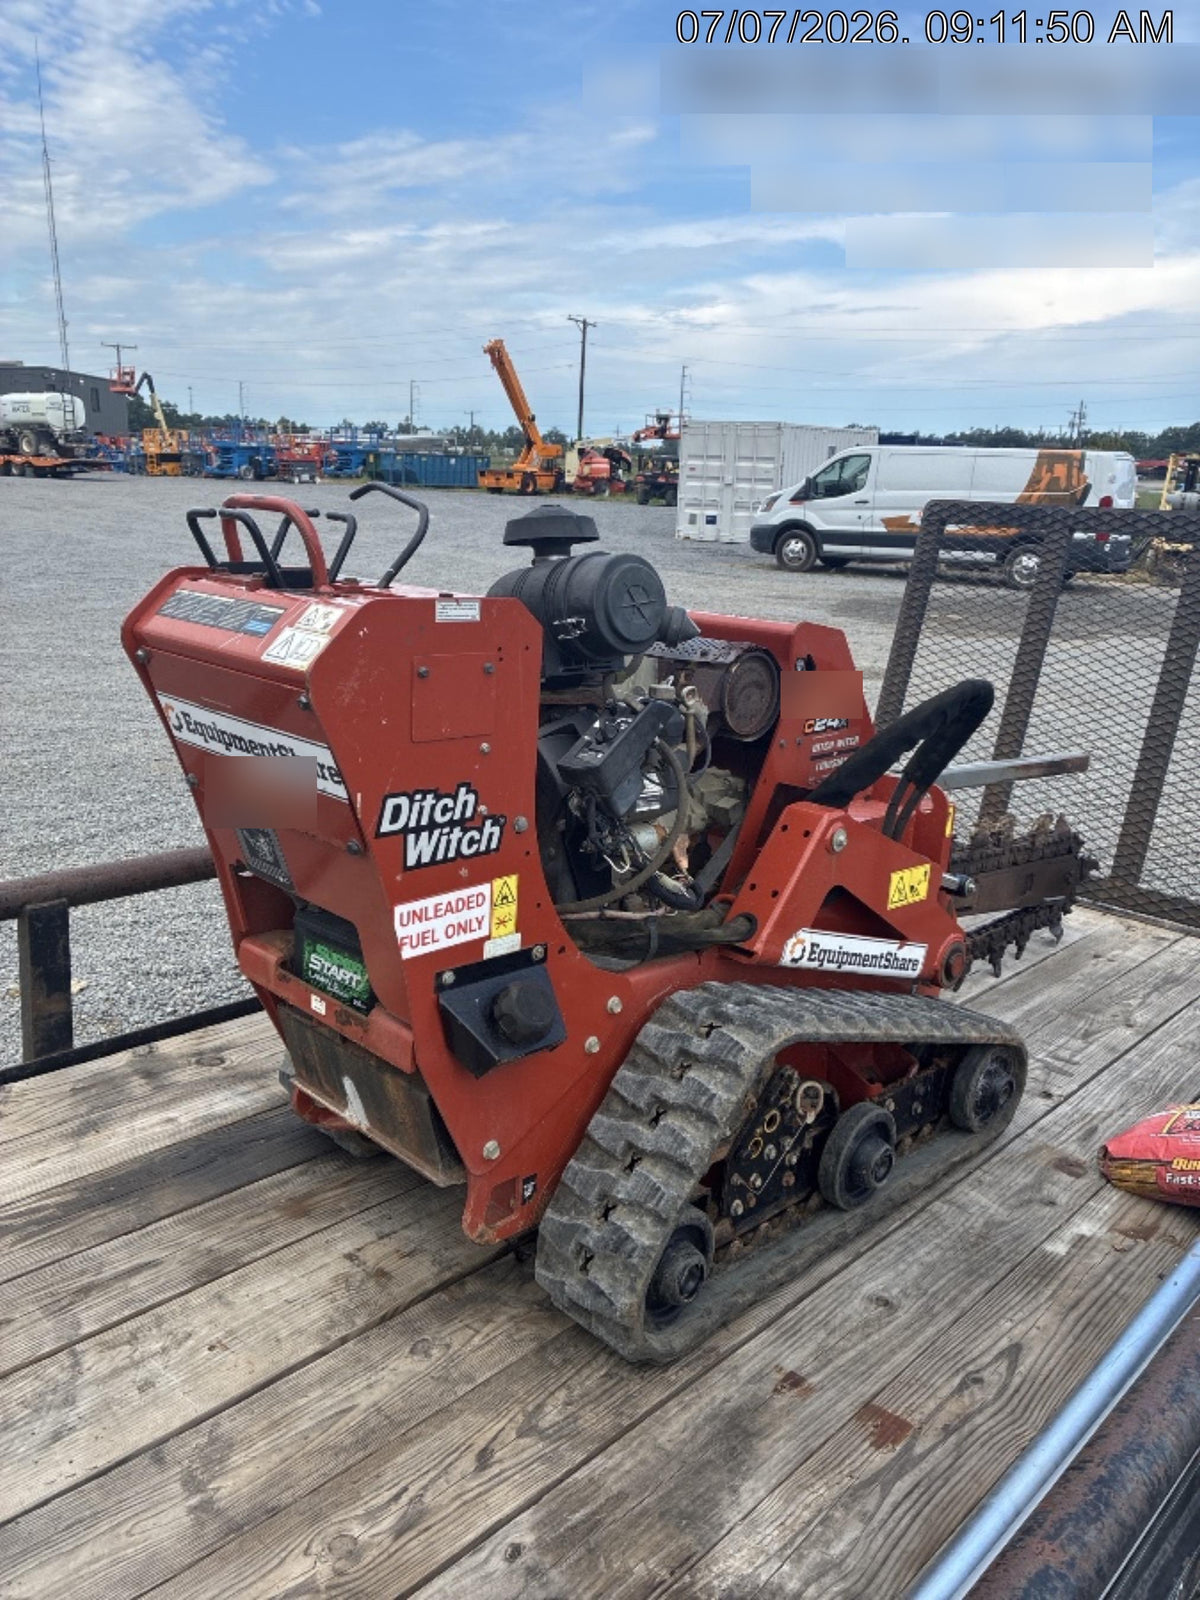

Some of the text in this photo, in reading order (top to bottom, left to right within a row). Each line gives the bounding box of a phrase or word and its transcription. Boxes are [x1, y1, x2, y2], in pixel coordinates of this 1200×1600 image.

[379, 785, 476, 833] Ditch
[406, 818, 501, 867] Witch
[399, 891, 487, 928] UNLEADED
[398, 914, 486, 950] FUEL ONLY
[808, 942, 920, 972] EquipmentShare
